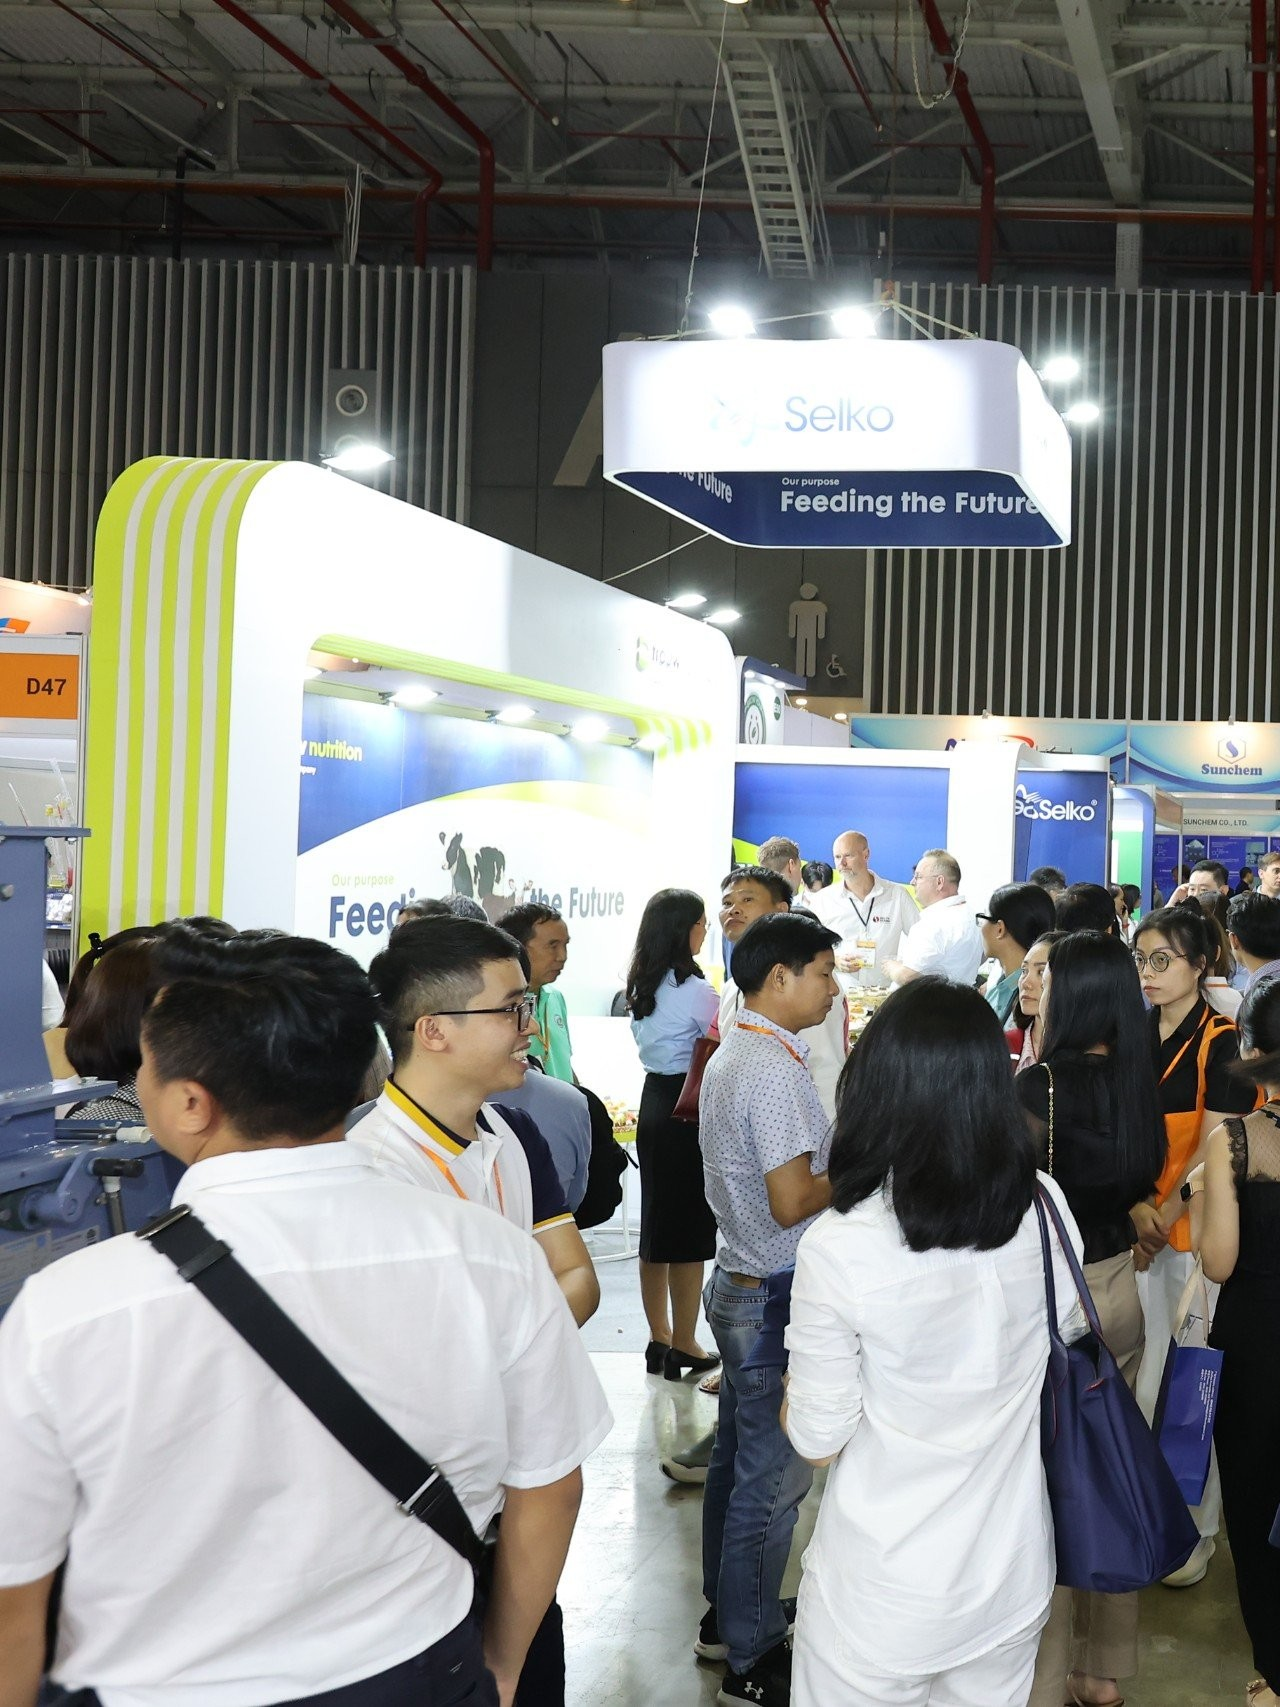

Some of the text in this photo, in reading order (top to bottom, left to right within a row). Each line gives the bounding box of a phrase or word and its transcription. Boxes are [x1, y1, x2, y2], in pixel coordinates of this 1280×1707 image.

[785, 396, 895, 433] Selko
[781, 477, 840, 488] Our purpose
[780, 488, 1042, 518] Feeding the Future
[27, 677, 67, 696] D47
[308, 739, 363, 762] nutrition
[1201, 763, 1263, 776] Sunchem
[1039, 800, 1095, 821] Selko
[1183, 818, 1218, 826] SUNCHEM
[331, 874, 395, 888] Our purpose
[569, 886, 625, 919] Future
